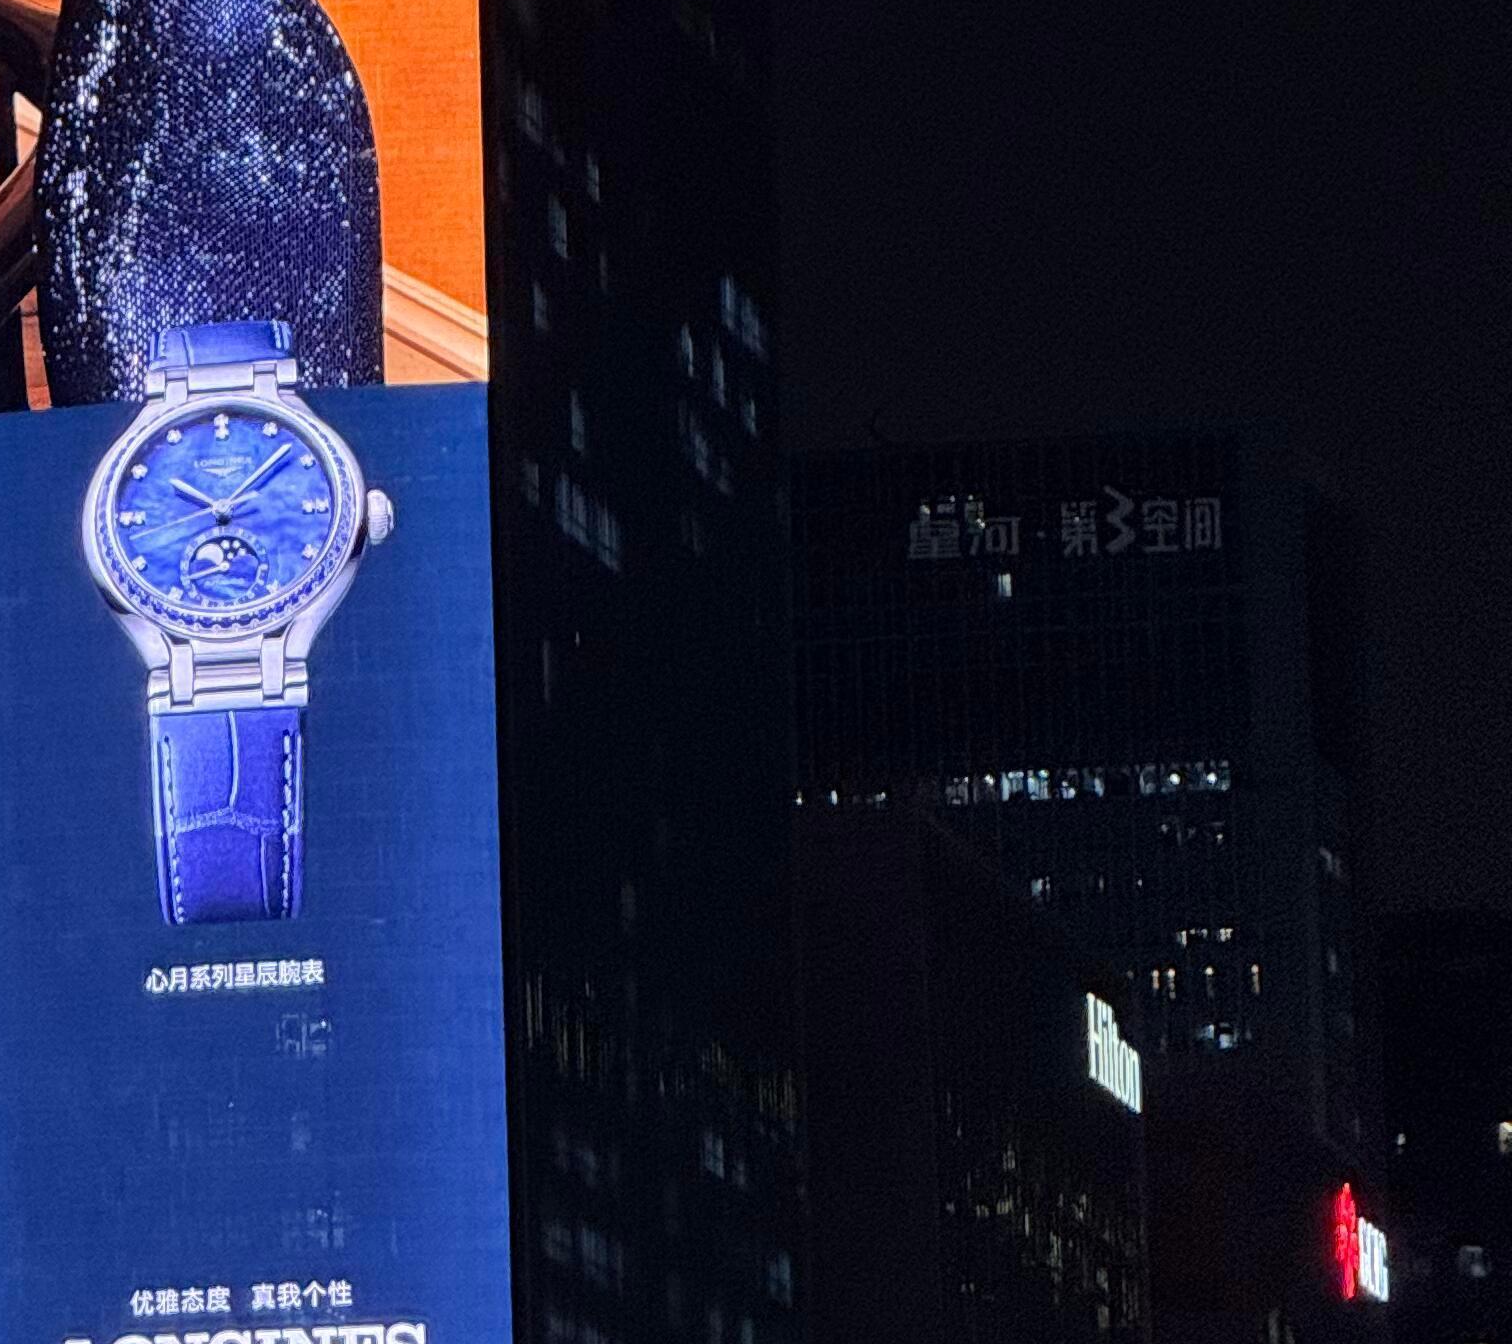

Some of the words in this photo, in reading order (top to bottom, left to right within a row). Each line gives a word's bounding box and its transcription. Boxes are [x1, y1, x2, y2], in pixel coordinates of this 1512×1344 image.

[144, 957, 326, 994] 心月系列星辰腕表
[1086, 991, 1143, 1114] Hilton
[130, 1285, 231, 1317] 优雅态度
[251, 1278, 354, 1311] 真我个性
